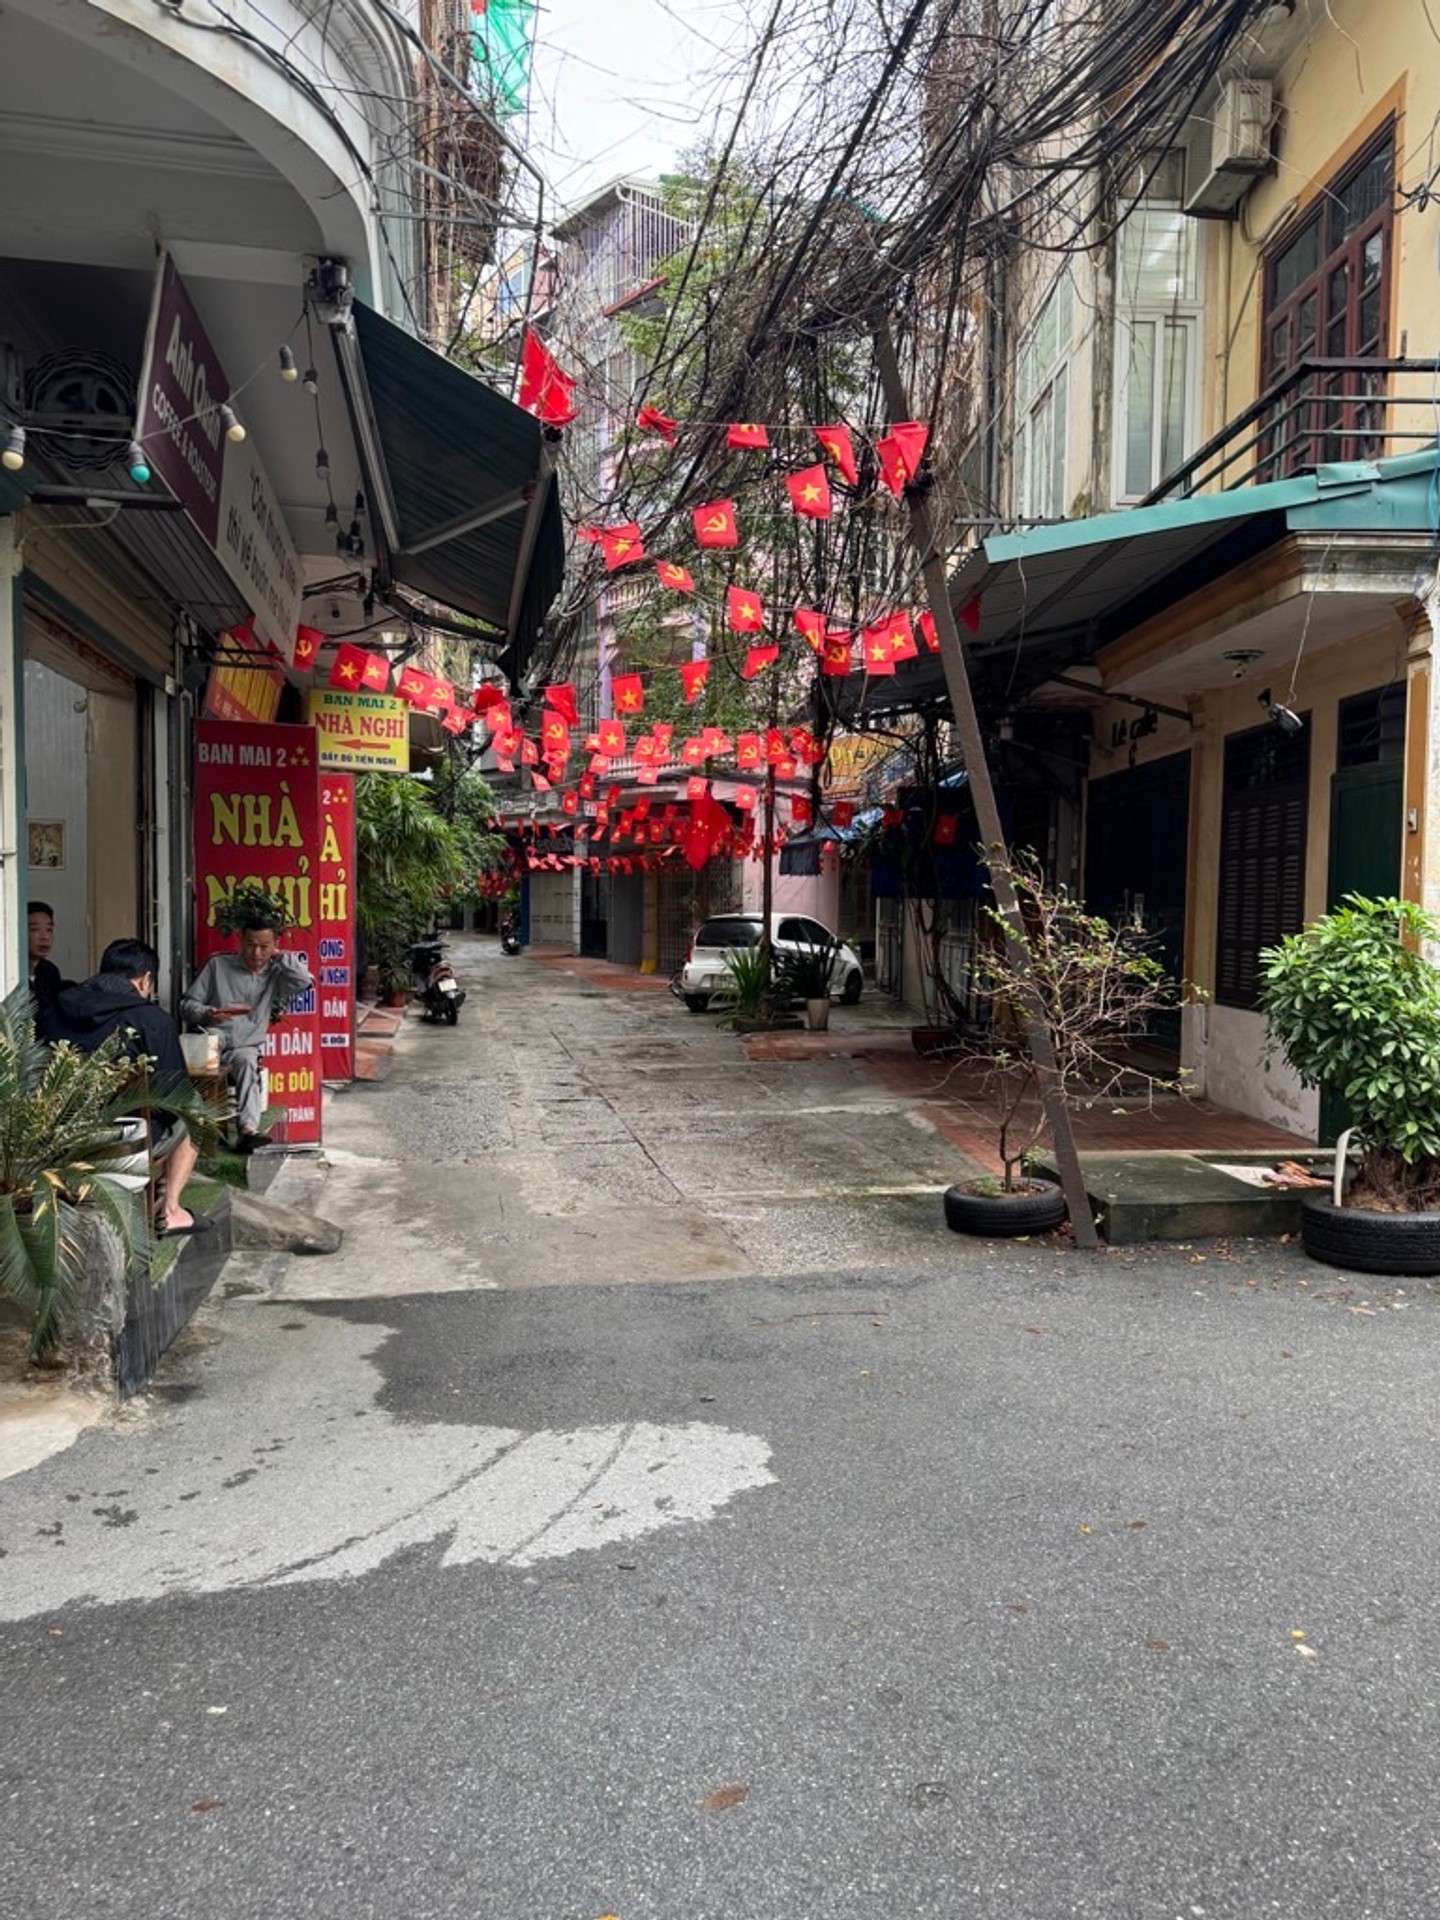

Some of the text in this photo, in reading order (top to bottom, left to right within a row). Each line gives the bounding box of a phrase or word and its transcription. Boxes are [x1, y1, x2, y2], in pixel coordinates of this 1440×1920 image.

[166, 313, 194, 399] Anh
[153, 383, 182, 448] COFFEE
[324, 694, 397, 709] BAN MAI 2
[315, 709, 405, 738] NHÀ NGHỈ
[199, 743, 287, 767] BAN MAI 2
[322, 790, 331, 805] 2
[210, 780, 303, 847] NHÀ
[205, 854, 313, 928] NHỈ
[281, 1027, 313, 1055] DÂN
[288, 1066, 314, 1093] ĐÔI
